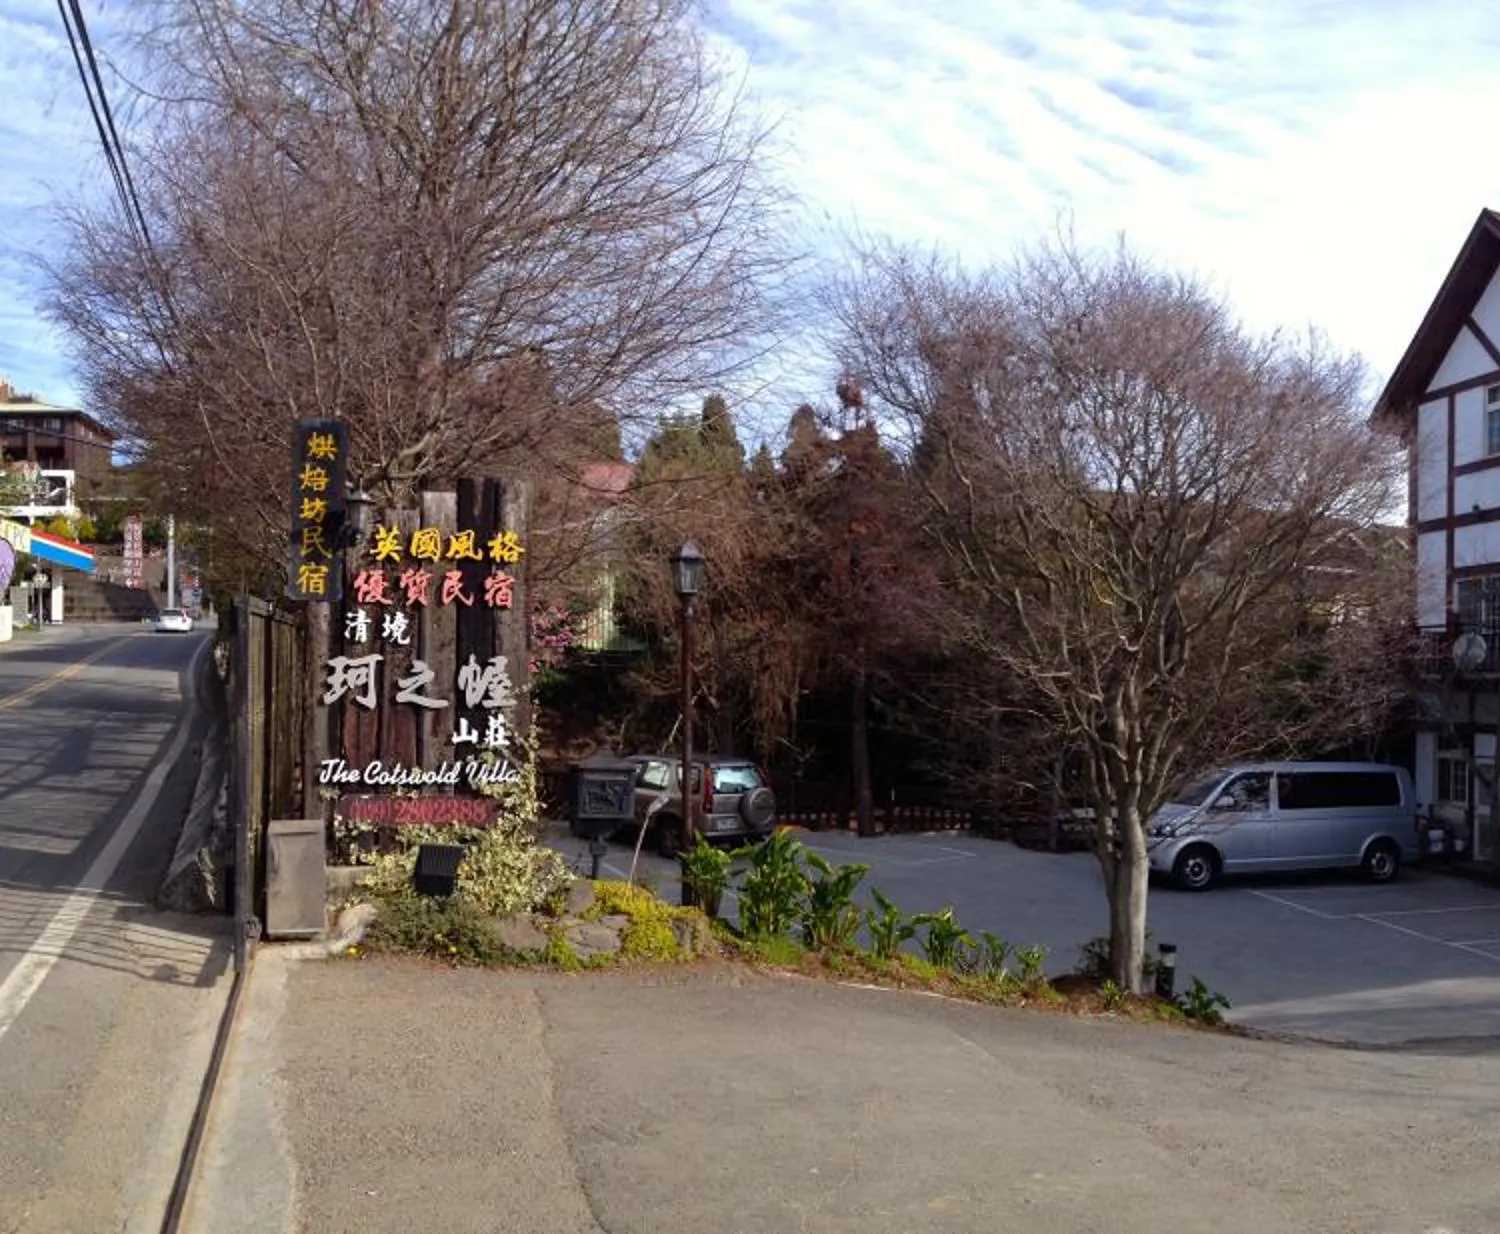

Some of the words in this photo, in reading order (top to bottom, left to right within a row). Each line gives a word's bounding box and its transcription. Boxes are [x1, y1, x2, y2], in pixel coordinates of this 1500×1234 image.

[296, 431, 338, 596] 烘焙坊民宿
[370, 525, 526, 563] 英國風格
[353, 568, 517, 608] 優質民宿
[344, 609, 411, 645] 清境
[451, 713, 511, 748] 山莊
[319, 759, 361, 784] The
[363, 760, 462, 785] Cotswold
[465, 759, 520, 786] Villa
